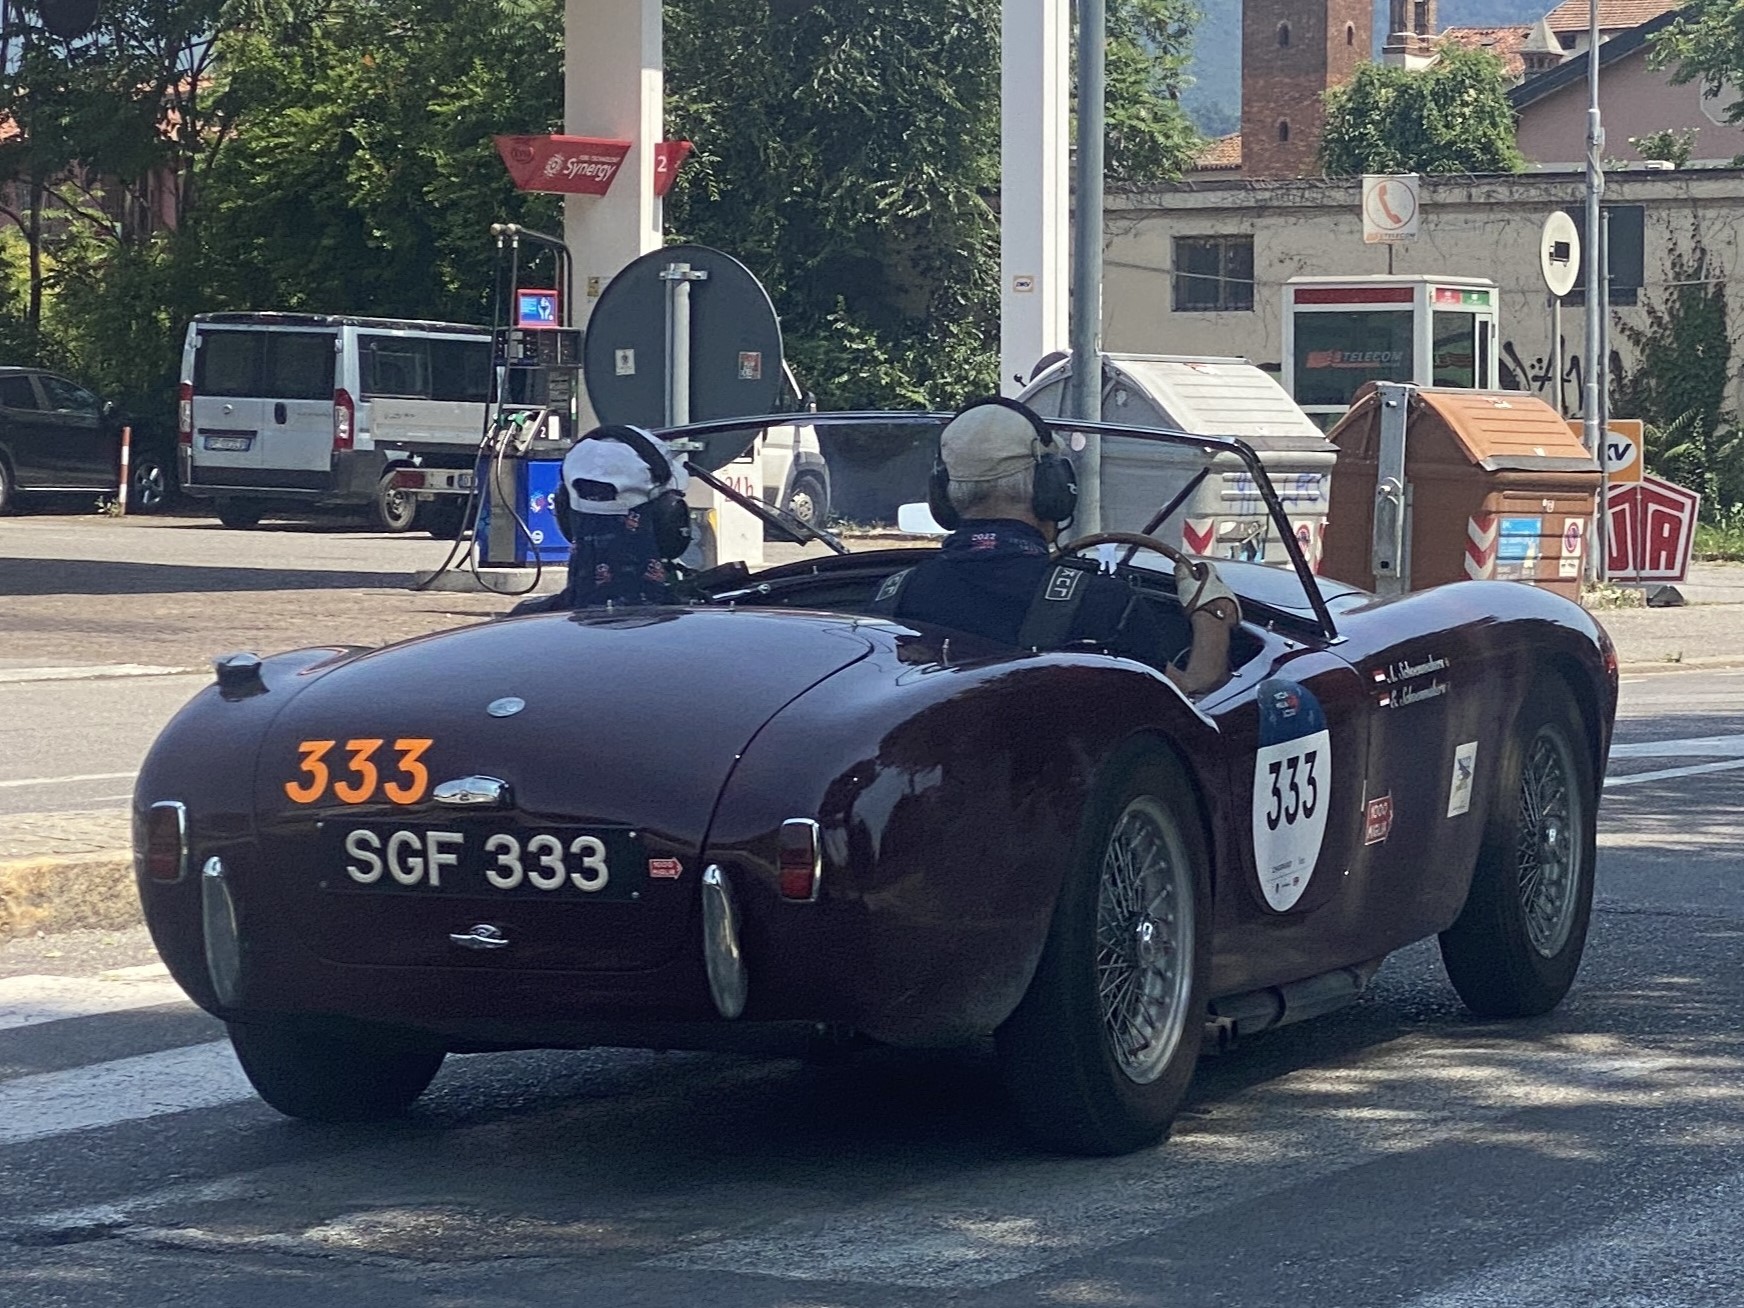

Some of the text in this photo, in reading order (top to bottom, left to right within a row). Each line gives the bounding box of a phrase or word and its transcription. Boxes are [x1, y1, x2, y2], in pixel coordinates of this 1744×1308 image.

[563, 157, 617, 181] Synergy
[657, 155, 668, 172] 2
[1343, 351, 1403, 363] TELECOM
[539, 426, 547, 438] 2
[1598, 443, 1632, 461] KV
[284, 738, 434, 804] 333
[1266, 750, 1317, 831] 333
[344, 829, 610, 893] SGF 333
